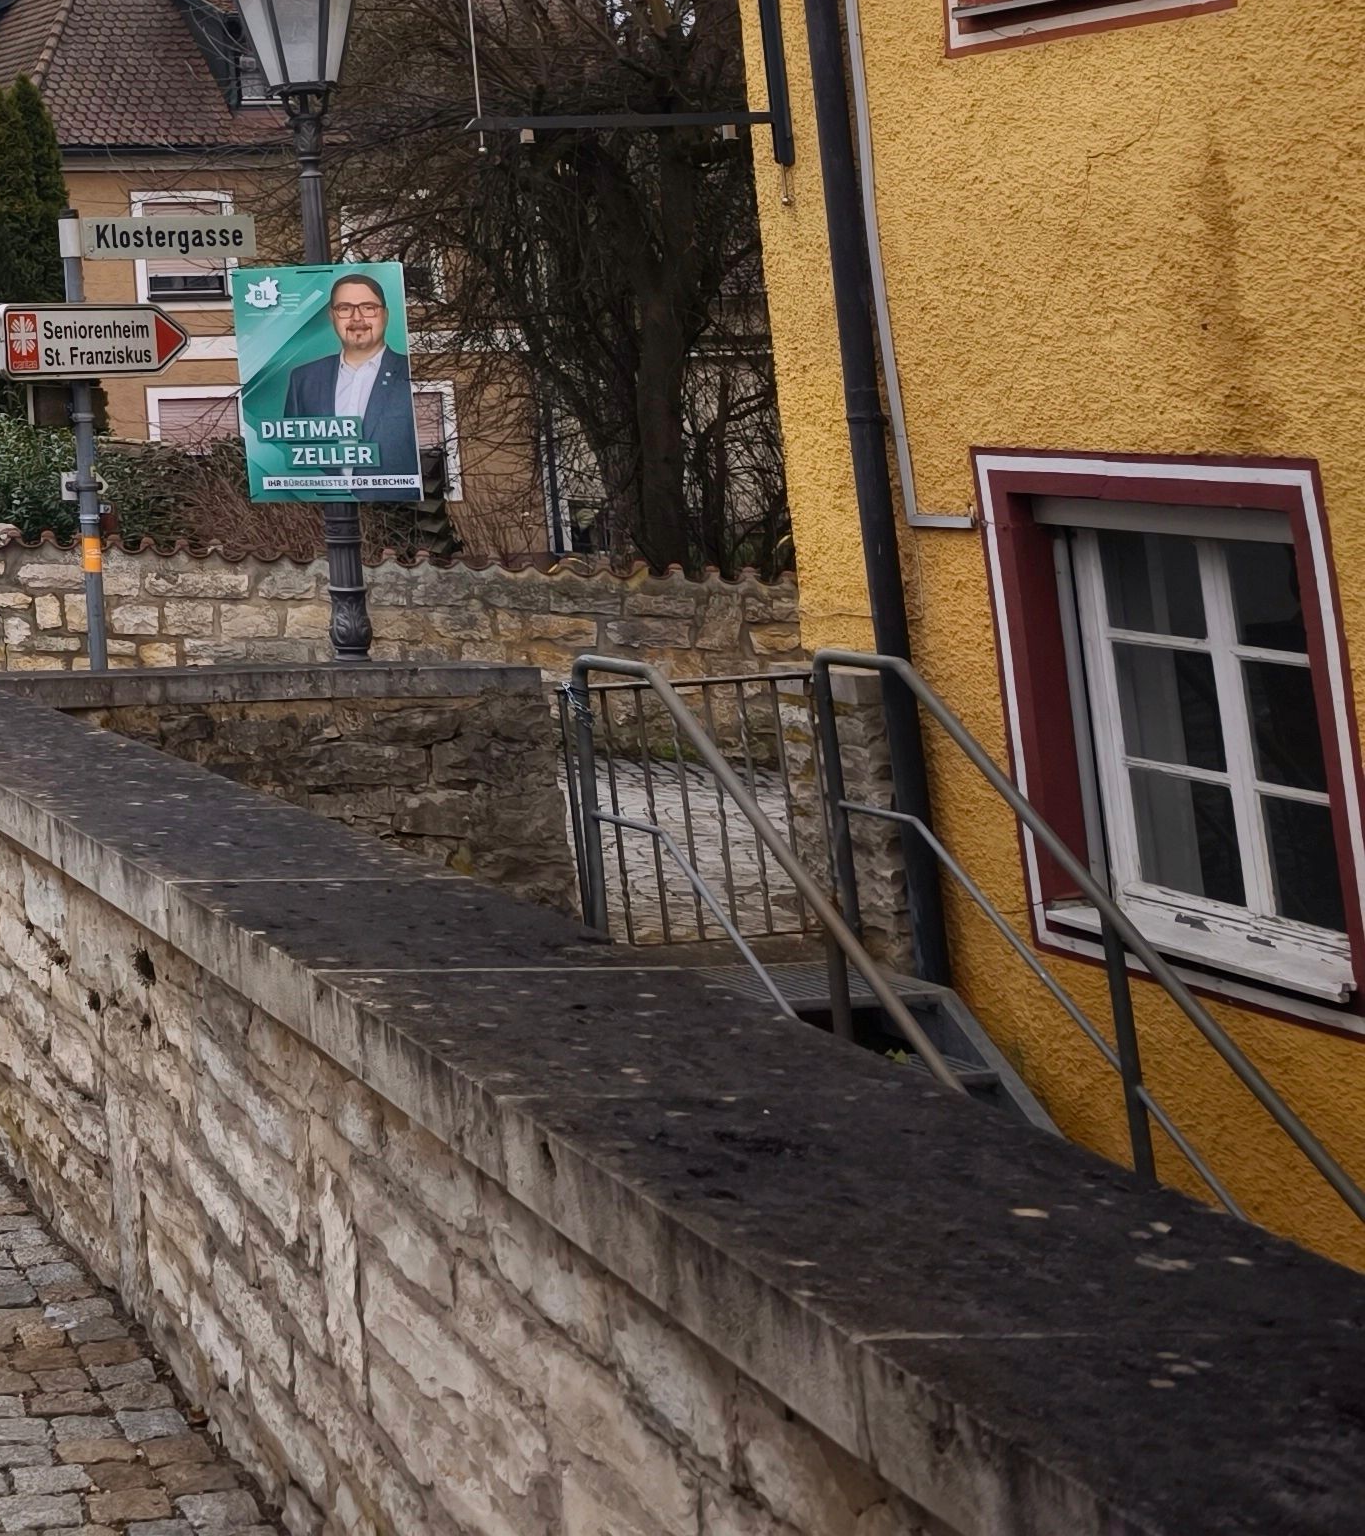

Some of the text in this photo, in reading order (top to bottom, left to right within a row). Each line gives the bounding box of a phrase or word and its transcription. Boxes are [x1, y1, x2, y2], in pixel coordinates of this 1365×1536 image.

[95, 224, 243, 254] Klostergasse
[254, 290, 271, 301] BL
[43, 320, 150, 340] Seniorenheim
[44, 344, 152, 366] St. Franziskus
[261, 419, 358, 439] DIETMAR
[292, 446, 373, 465] ZELLER
[268, 476, 415, 487] IHR BÜRGERMEISTER FÜR BERCHING
